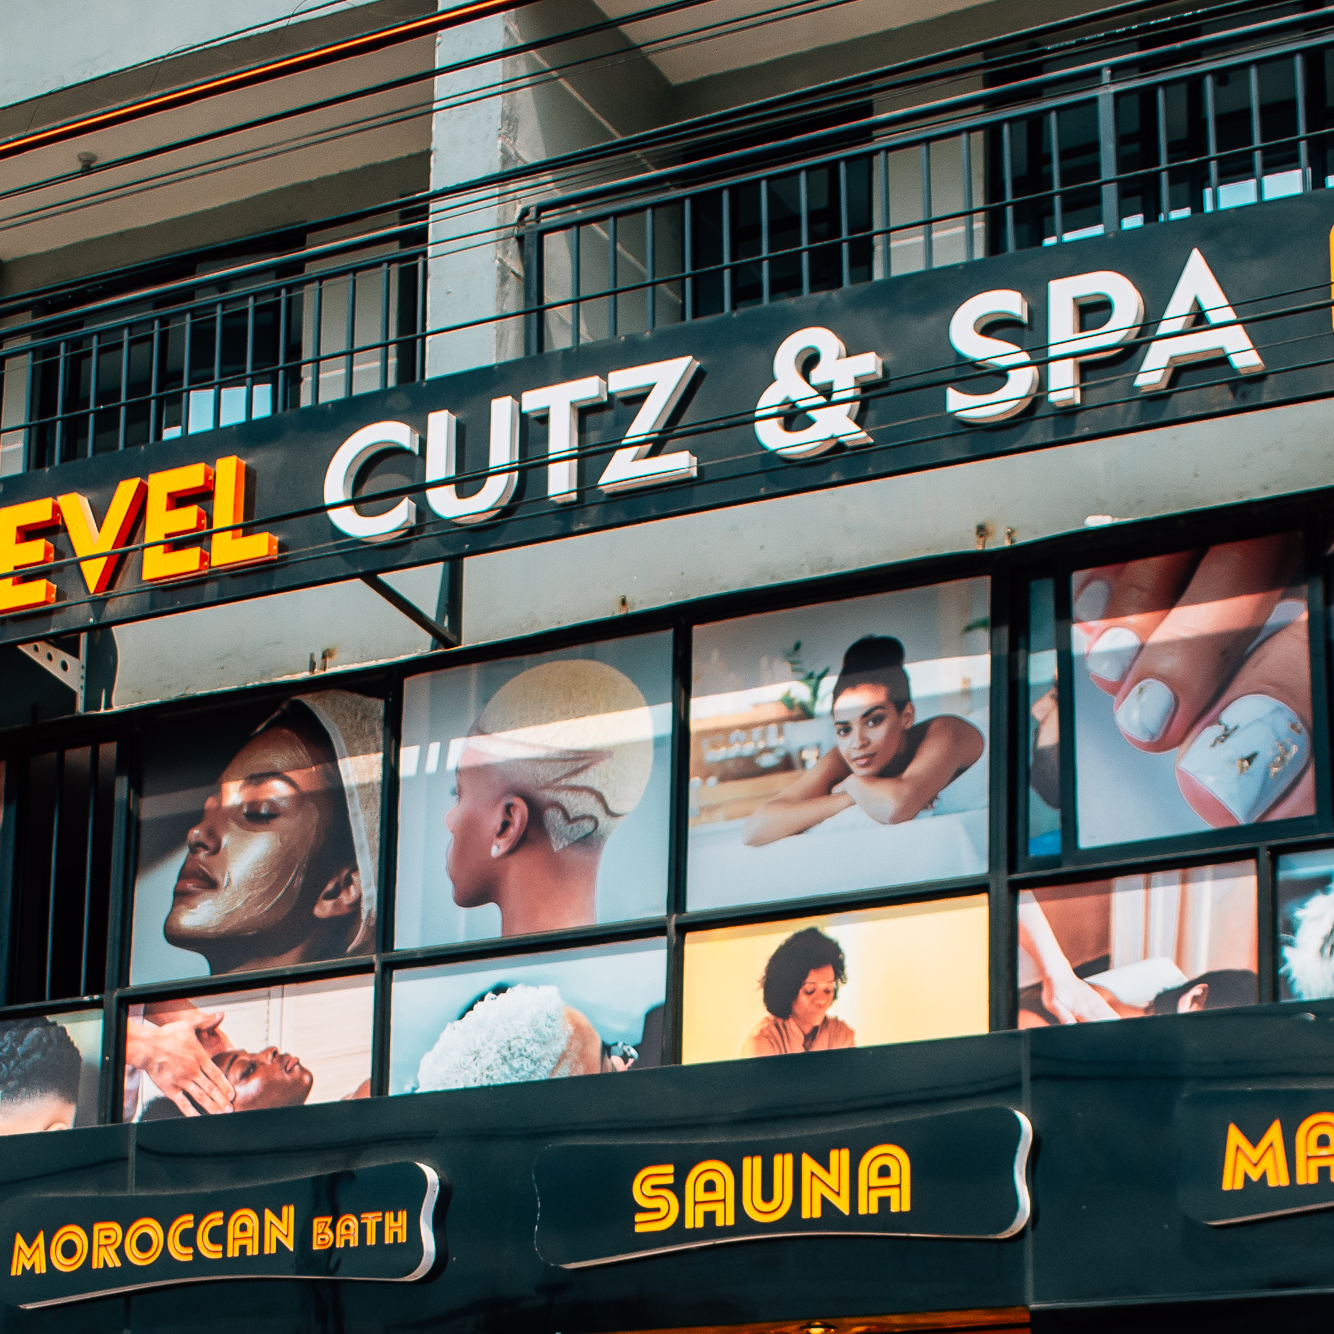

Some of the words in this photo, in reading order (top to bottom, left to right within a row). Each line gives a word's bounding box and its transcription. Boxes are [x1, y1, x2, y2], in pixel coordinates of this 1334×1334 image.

[323, 356, 700, 541] CUTZ
[754, 327, 882, 461] &
[945, 247, 1264, 423] SPA
[633, 1142, 911, 1233] SAUNA
[10, 1204, 295, 1277] MOROCCAN
[312, 1209, 408, 1251] BATH
